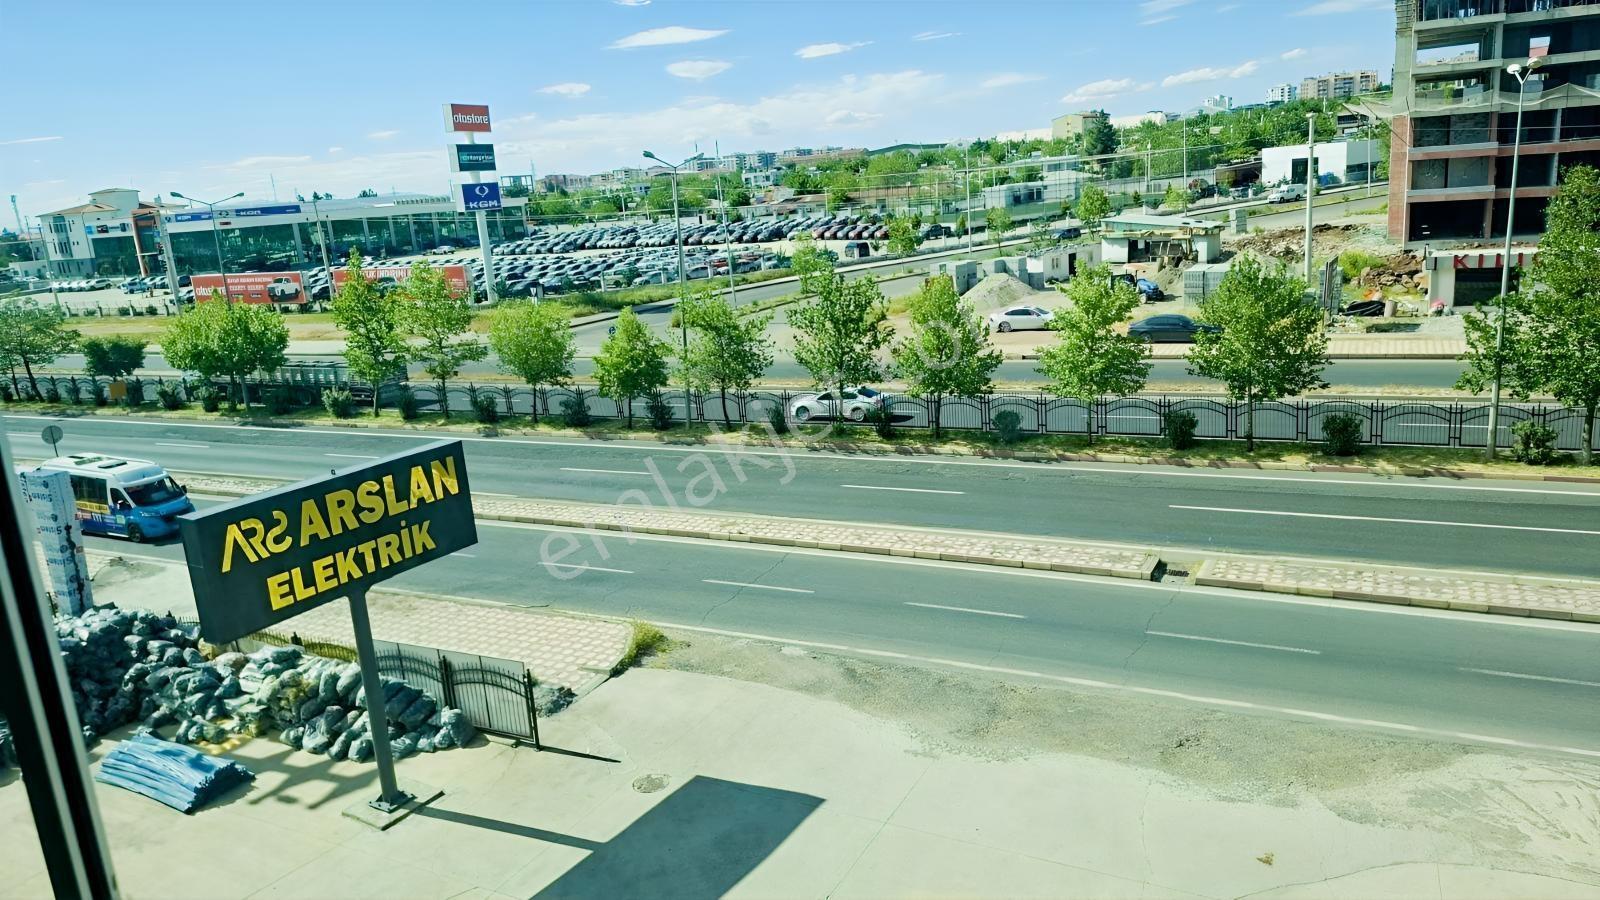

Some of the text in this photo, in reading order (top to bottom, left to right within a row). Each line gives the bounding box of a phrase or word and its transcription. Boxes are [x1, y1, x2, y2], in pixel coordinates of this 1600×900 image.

[453, 113, 489, 124] otostore
[469, 200, 498, 209] KGM
[1453, 253, 1538, 271] KILI
[300, 456, 459, 547] ARSLAN
[266, 520, 436, 611] ELEKTRİK
